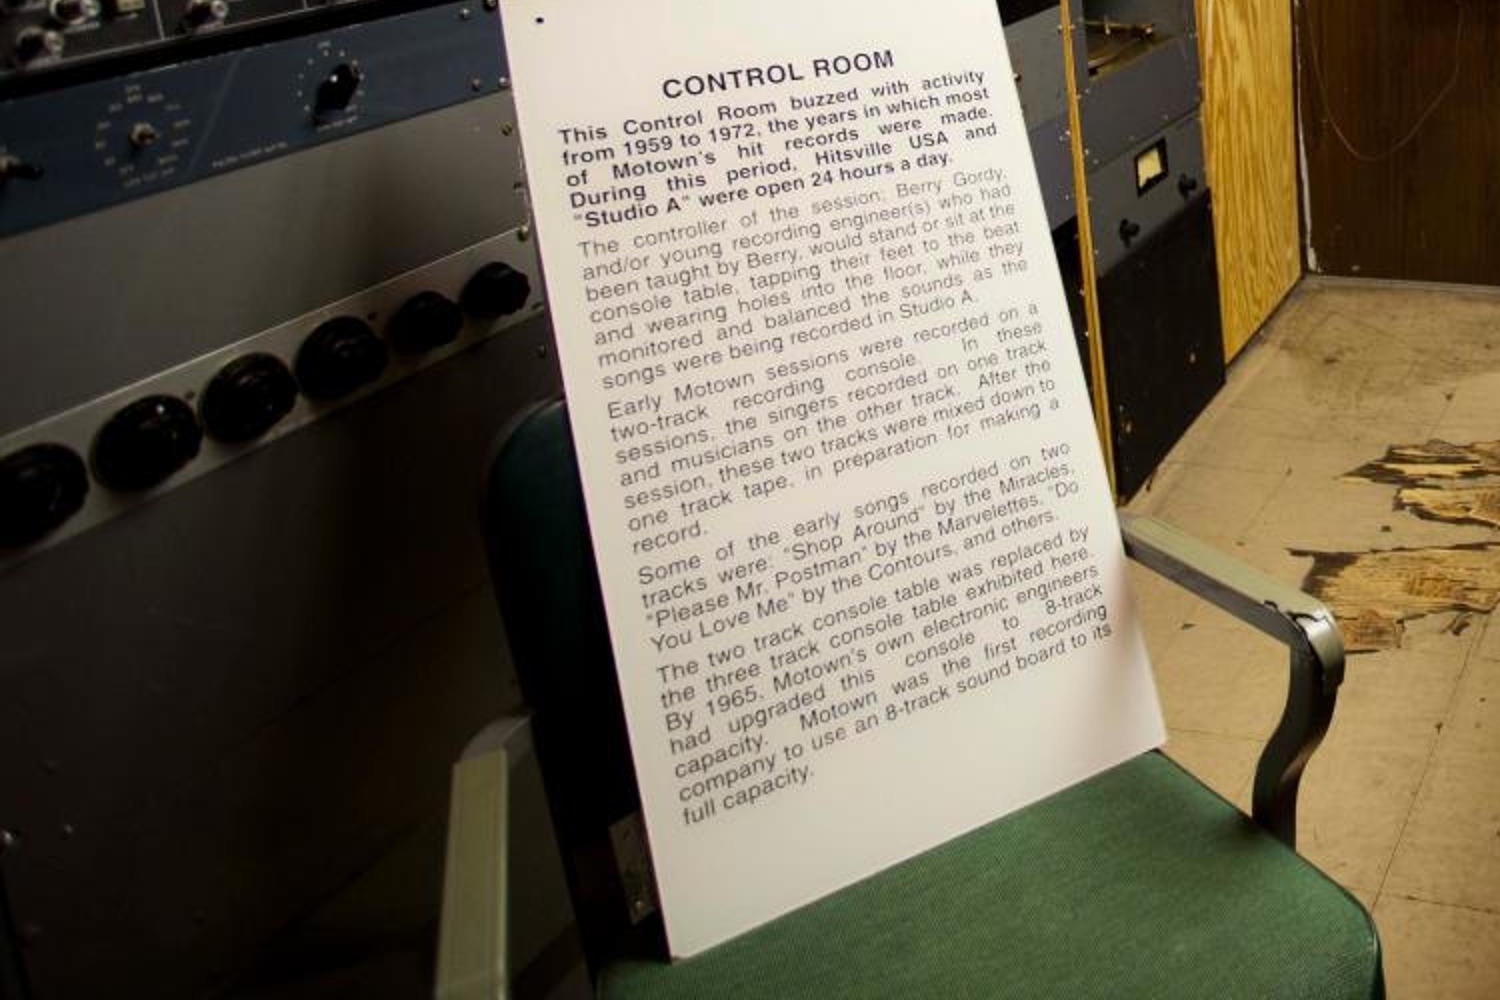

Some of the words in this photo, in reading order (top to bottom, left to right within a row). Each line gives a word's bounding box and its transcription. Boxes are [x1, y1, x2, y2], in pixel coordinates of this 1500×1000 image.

[556, 124, 608, 145] This
[622, 108, 703, 135] Control
[716, 100, 777, 121] Room
[788, 86, 859, 111] buzzed
[869, 78, 909, 97] with
[920, 70, 985, 91] activity
[660, 61, 805, 99] CONTROL
[811, 48, 895, 78] ROOM
[560, 146, 615, 167] from
[622, 134, 673, 156] 1959
[678, 132, 701, 148] to
[766, 116, 799, 134] the
[803, 108, 858, 132] years
[862, 103, 881, 118] in
[885, 94, 941, 115] which
[944, 86, 990, 106] most
[565, 167, 588, 187] of
[736, 141, 764, 160] hit
[783, 126, 859, 151] records
[876, 118, 922, 135] were
[568, 184, 647, 209] During
[665, 172, 707, 192] this
[814, 140, 892, 167] Hitsville
[907, 129, 949, 150] USA
[964, 120, 997, 141] and
[575, 239, 619, 258] The
[632, 218, 726, 248] controller
[895, 179, 942, 198] Berry
[697, 186, 749, 207] were
[754, 176, 805, 199] open
[809, 168, 834, 187] 24
[838, 161, 895, 182] hours
[899, 158, 911, 171] a
[582, 254, 650, 281] and/or
[659, 241, 723, 269] young
[731, 221, 821, 251] recording
[584, 279, 639, 302] been
[645, 263, 711, 290] taught
[807, 231, 863, 256] would
[868, 220, 917, 244] stand
[588, 294, 672, 323] console
[748, 263, 821, 290] tapping
[829, 253, 869, 273] their
[879, 242, 913, 261] feet
[982, 220, 1019, 240] beat
[593, 321, 634, 345] and
[645, 304, 727, 334] wearing
[736, 290, 791, 313] holes
[800, 281, 835, 299] into
[935, 249, 979, 270] while
[987, 241, 1023, 259] they
[597, 329, 703, 368] monitored
[715, 317, 753, 341] and
[763, 295, 851, 329] balanced
[900, 273, 963, 299] sounds
[601, 363, 667, 389] songs
[671, 350, 723, 373] were
[728, 336, 784, 360] being
[789, 311, 873, 345] recorded
[898, 296, 955, 319] Studio
[606, 393, 661, 419] Early
[672, 372, 755, 402] Motown
[764, 348, 849, 381] sessions
[858, 334, 903, 357] were
[912, 311, 989, 342] recorded
[609, 403, 709, 443] two-track
[732, 376, 825, 411] recording
[996, 321, 1042, 343] these
[619, 460, 661, 487] and
[670, 434, 774, 472] musicians
[855, 398, 902, 422] other
[977, 368, 1016, 390] After
[724, 415, 757, 435] the
[767, 394, 838, 424] singers
[846, 369, 928, 402] recorded
[1005, 339, 1047, 361] track
[626, 508, 668, 532] one
[679, 488, 733, 517] track
[832, 432, 938, 477] preparation
[978, 402, 1041, 430] making
[717, 456, 774, 484] these
[819, 427, 879, 455] tracks
[882, 414, 927, 436] were
[932, 394, 985, 423] mixed
[989, 384, 1035, 407] down
[637, 554, 701, 585] Some
[746, 530, 781, 551] the
[792, 511, 840, 537] early
[852, 490, 909, 519] songs
[920, 459, 999, 498] recorded
[640, 576, 708, 609] tracks
[649, 629, 692, 653] You
[698, 610, 750, 638] Love
[655, 659, 699, 684] The
[706, 644, 745, 667] two
[752, 622, 804, 652] track
[812, 594, 887, 631] console
[893, 576, 940, 603] table
[990, 530, 1063, 570] replaced
[659, 685, 695, 709] the
[704, 662, 761, 693] three
[768, 639, 820, 670] track
[828, 612, 903, 649] console
[910, 593, 958, 620] table
[964, 559, 1044, 601] exhibited
[922, 596, 1009, 639] electronic
[1015, 564, 1098, 604] engineers
[668, 724, 711, 755] had
[727, 682, 826, 733] upgraded
[839, 668, 875, 692] this
[904, 631, 975, 667] console
[1044, 583, 1102, 615] 8-track
[798, 690, 878, 731] Motown
[983, 636, 1017, 660] first
[1028, 604, 1107, 643] recording
[678, 753, 776, 802] company
[884, 684, 951, 721] 8-track
[955, 658, 1011, 693] sound
[1014, 637, 1066, 670] board
[682, 796, 716, 825] full
